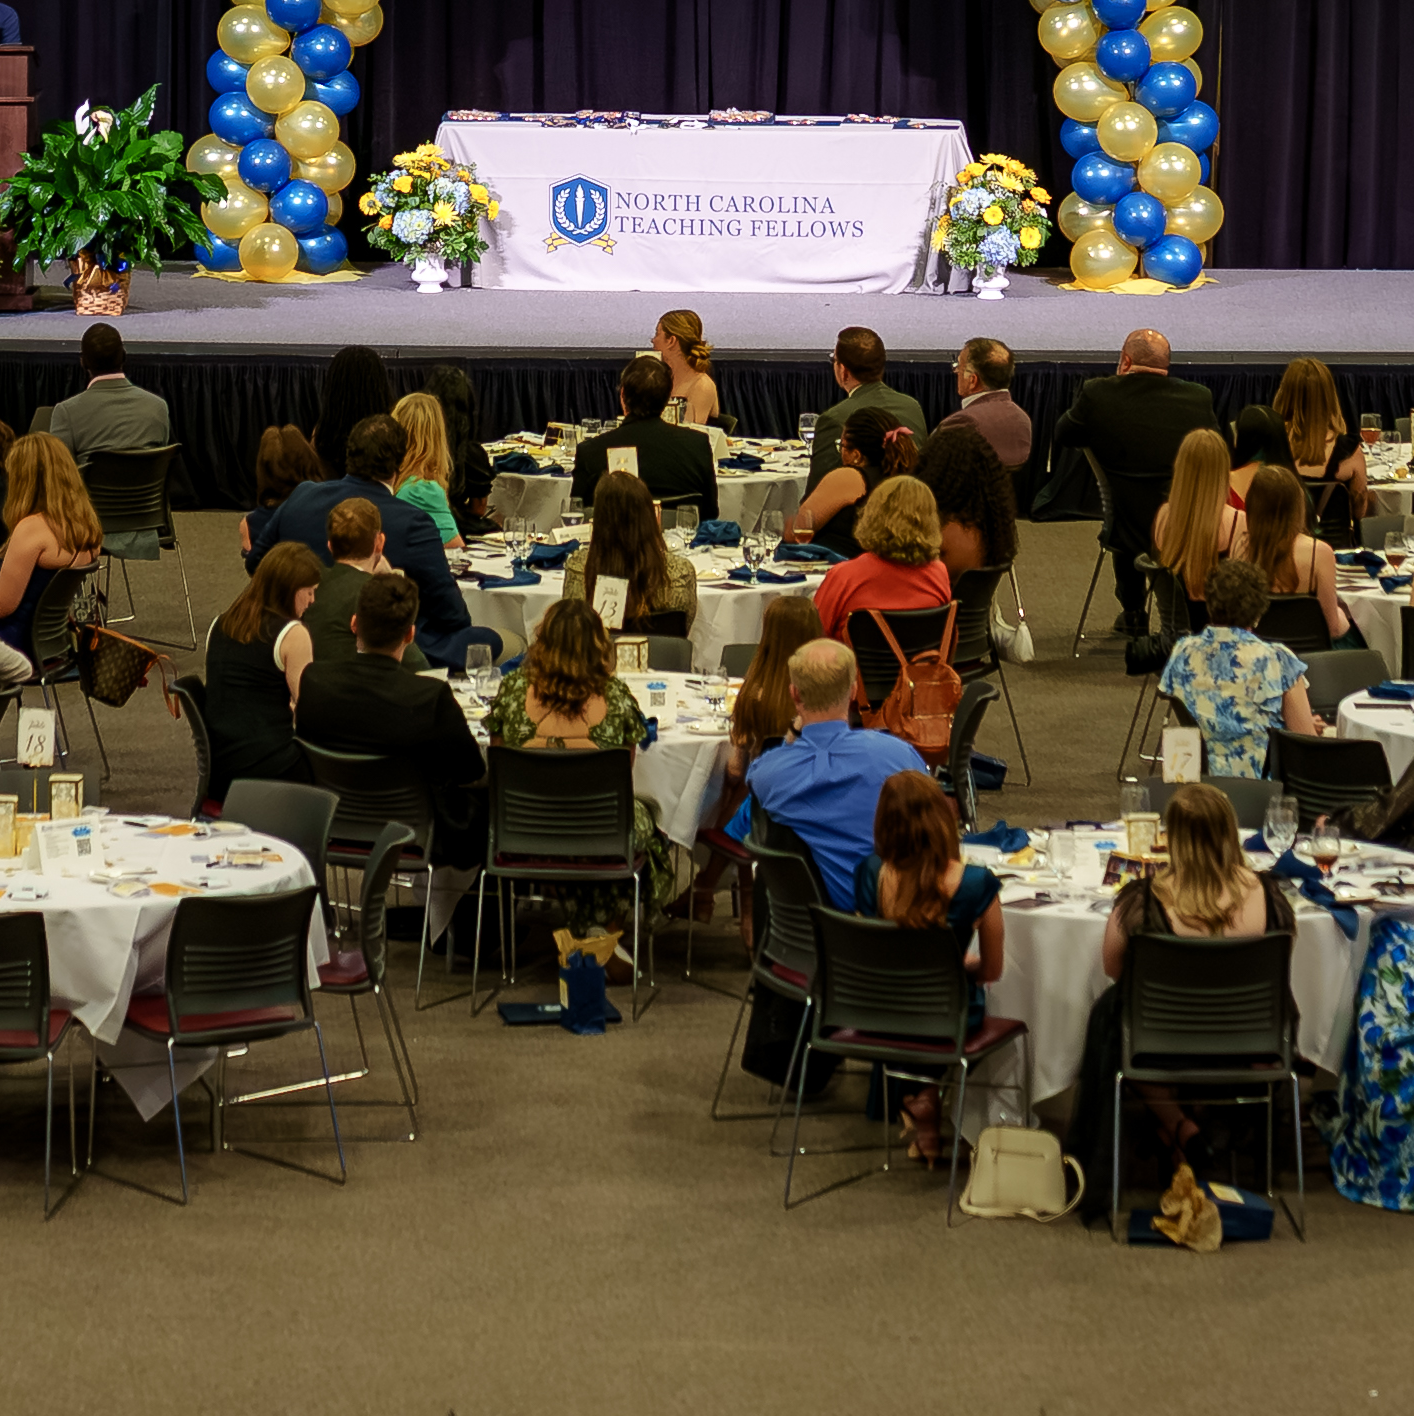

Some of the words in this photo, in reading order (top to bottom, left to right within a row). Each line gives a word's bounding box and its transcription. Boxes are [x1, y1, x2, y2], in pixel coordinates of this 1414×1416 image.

[614, 192, 702, 212] NORTH
[709, 195, 835, 215] CAROLINA
[614, 215, 743, 237] TEACHING
[750, 219, 864, 239] FELLOWS
[598, 600, 618, 618] 13
[26, 733, 46, 754] 18
[1170, 752, 1193, 771] 17
